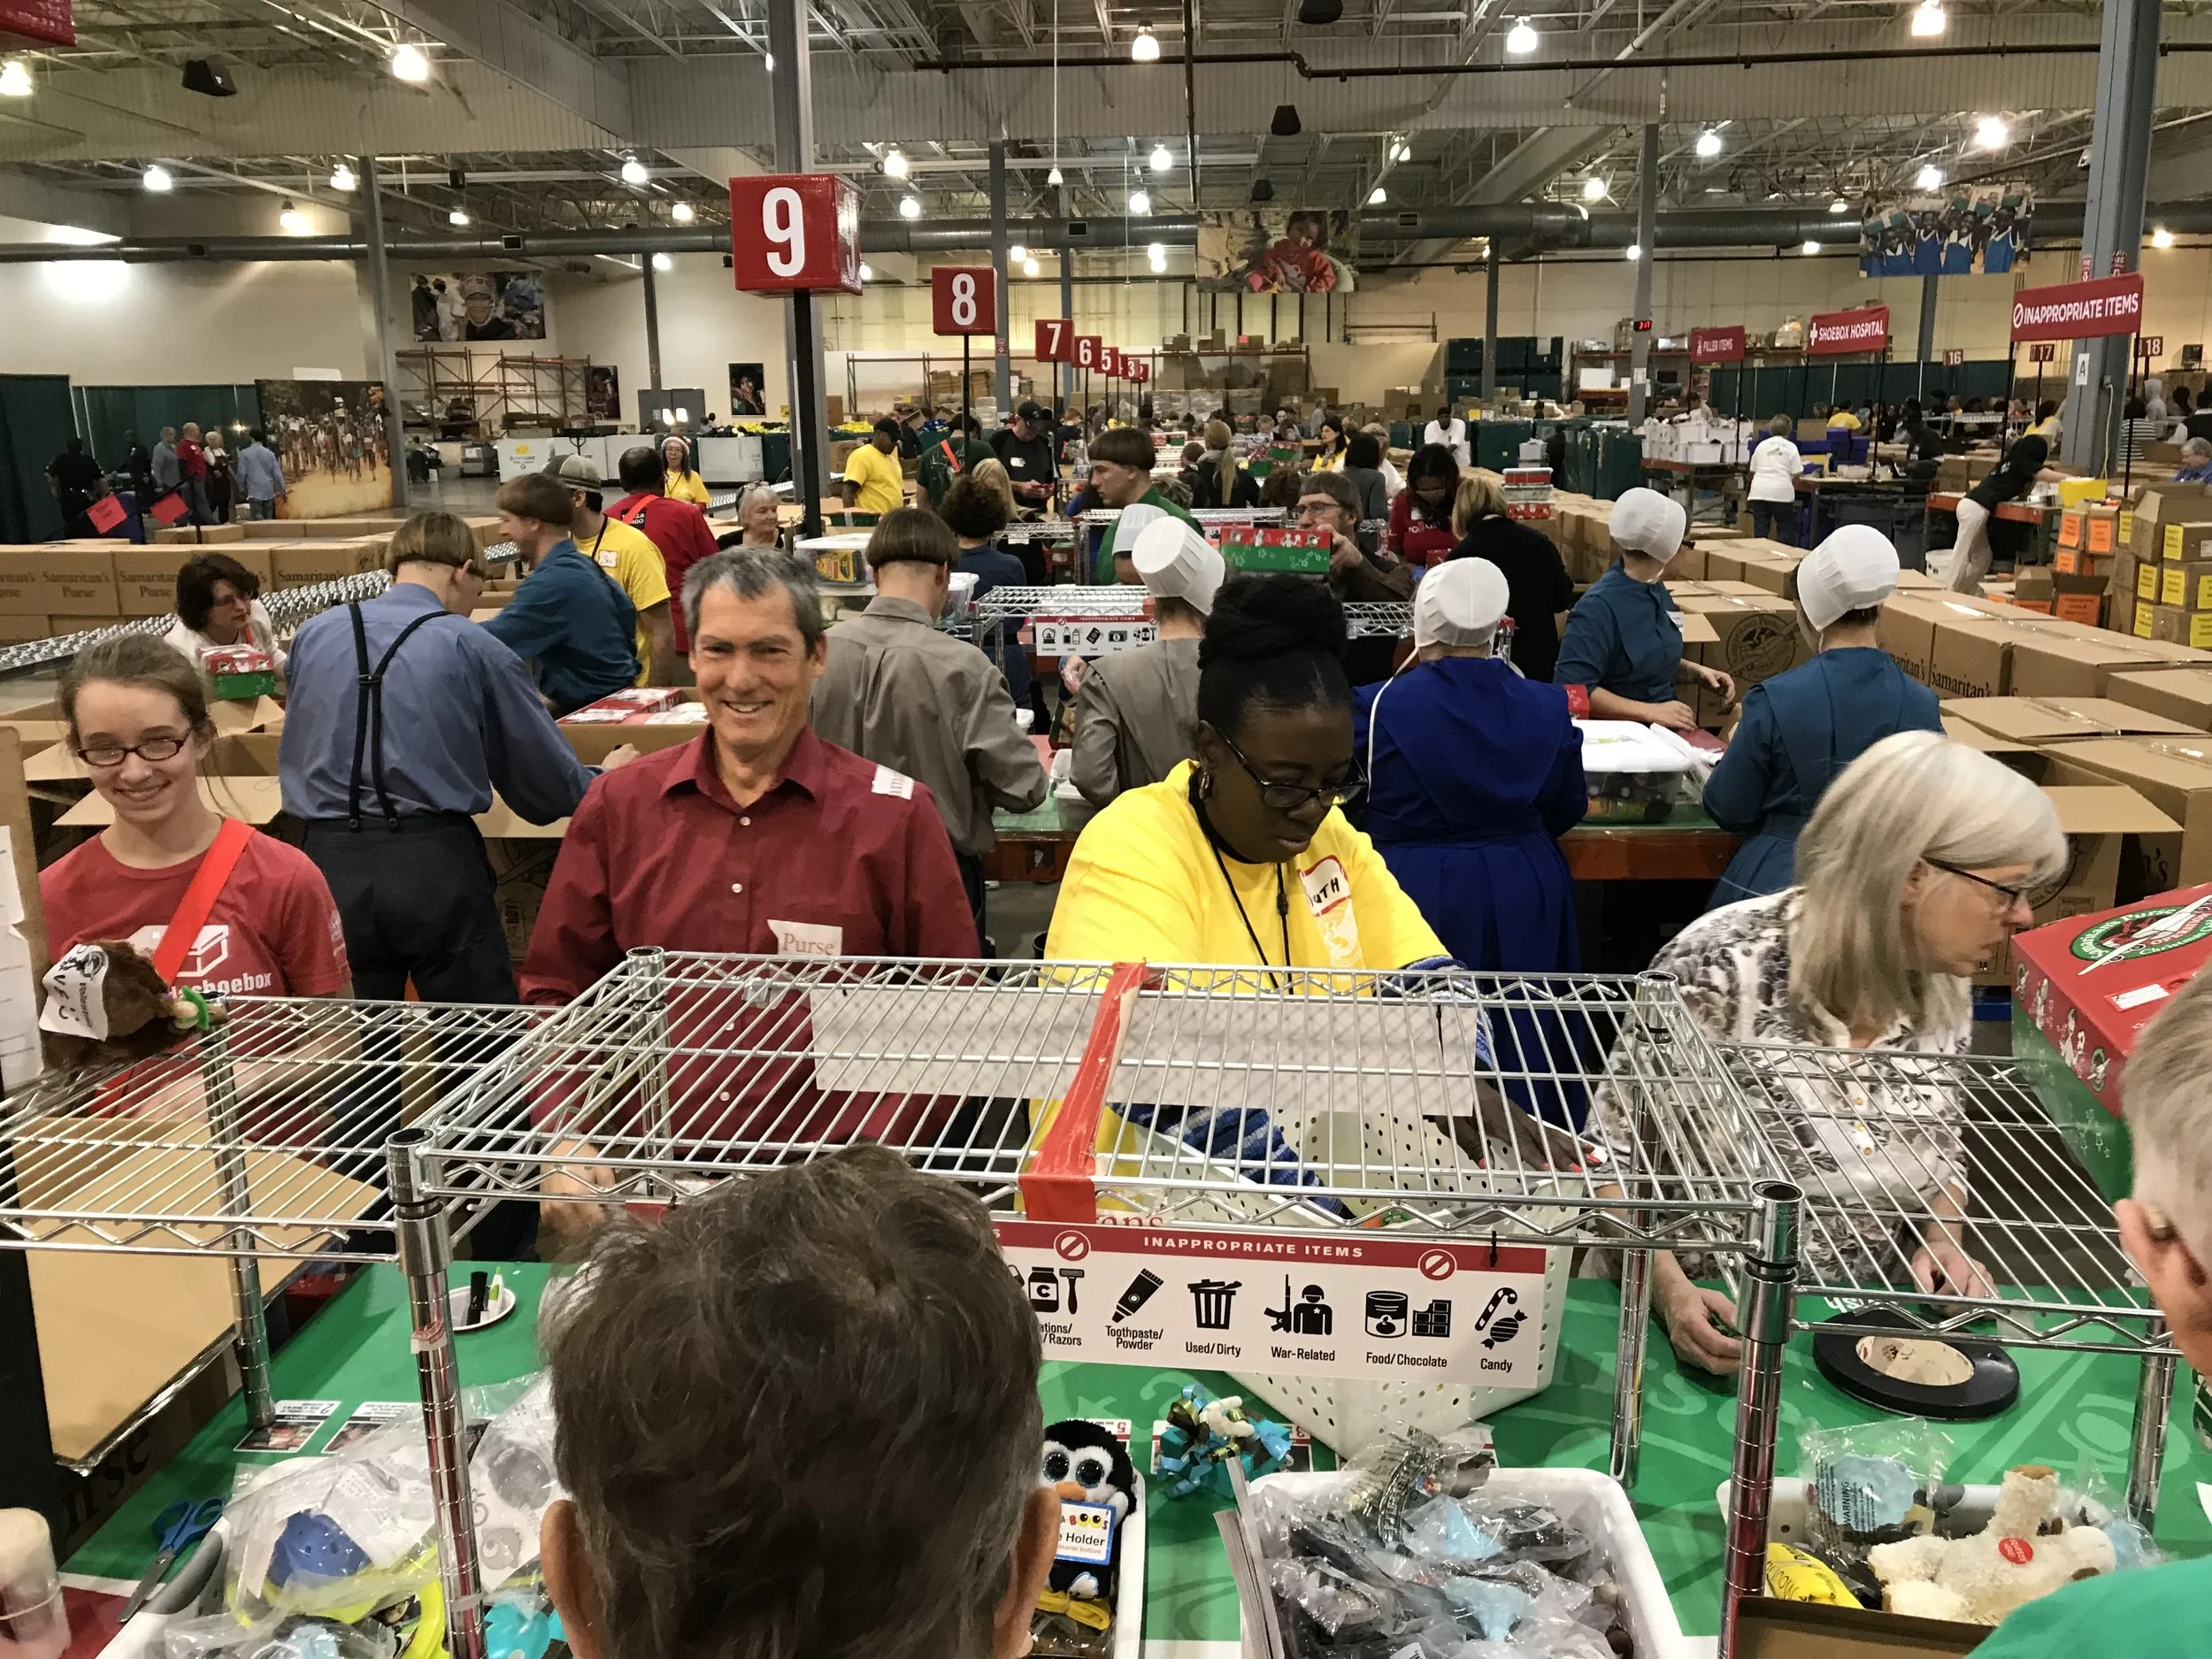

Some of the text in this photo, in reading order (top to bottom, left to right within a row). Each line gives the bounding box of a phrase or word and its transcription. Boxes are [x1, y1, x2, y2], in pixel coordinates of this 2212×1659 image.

[762, 187, 805, 277] 9
[951, 273, 977, 326] 8
[2024, 293, 2139, 325] INAPPROPRIATE ITEMS
[1047, 323, 1061, 354] 7
[1818, 320, 1885, 342] SHOEBOX HOSPITAL
[1079, 339, 1092, 365] 6
[2039, 345, 2052, 361] 17
[2147, 339, 2161, 356] 18
[1102, 349, 1111, 371] 5
[1948, 350, 1962, 365] 16
[1128, 359, 1135, 377] 3
[2079, 360, 2086, 374] A
[43, 572, 111, 582] Samaritan's
[61, 586, 96, 598] Purse
[140, 586, 172, 597] Purse
[2119, 908, 2177, 921] Purse
[783, 933, 834, 956] Purse
[1144, 1236, 1363, 1257] INAPPROPRIATE ITEMS
[1105, 1325, 1164, 1341] Toothpaste/
[1116, 1336, 1154, 1351] Powder
[1271, 1346, 1336, 1362] War-Related
[1479, 1358, 1513, 1372] Candy
[1117, 1422, 1126, 1433] 5
[1066, 1532, 1105, 1547] Holder
